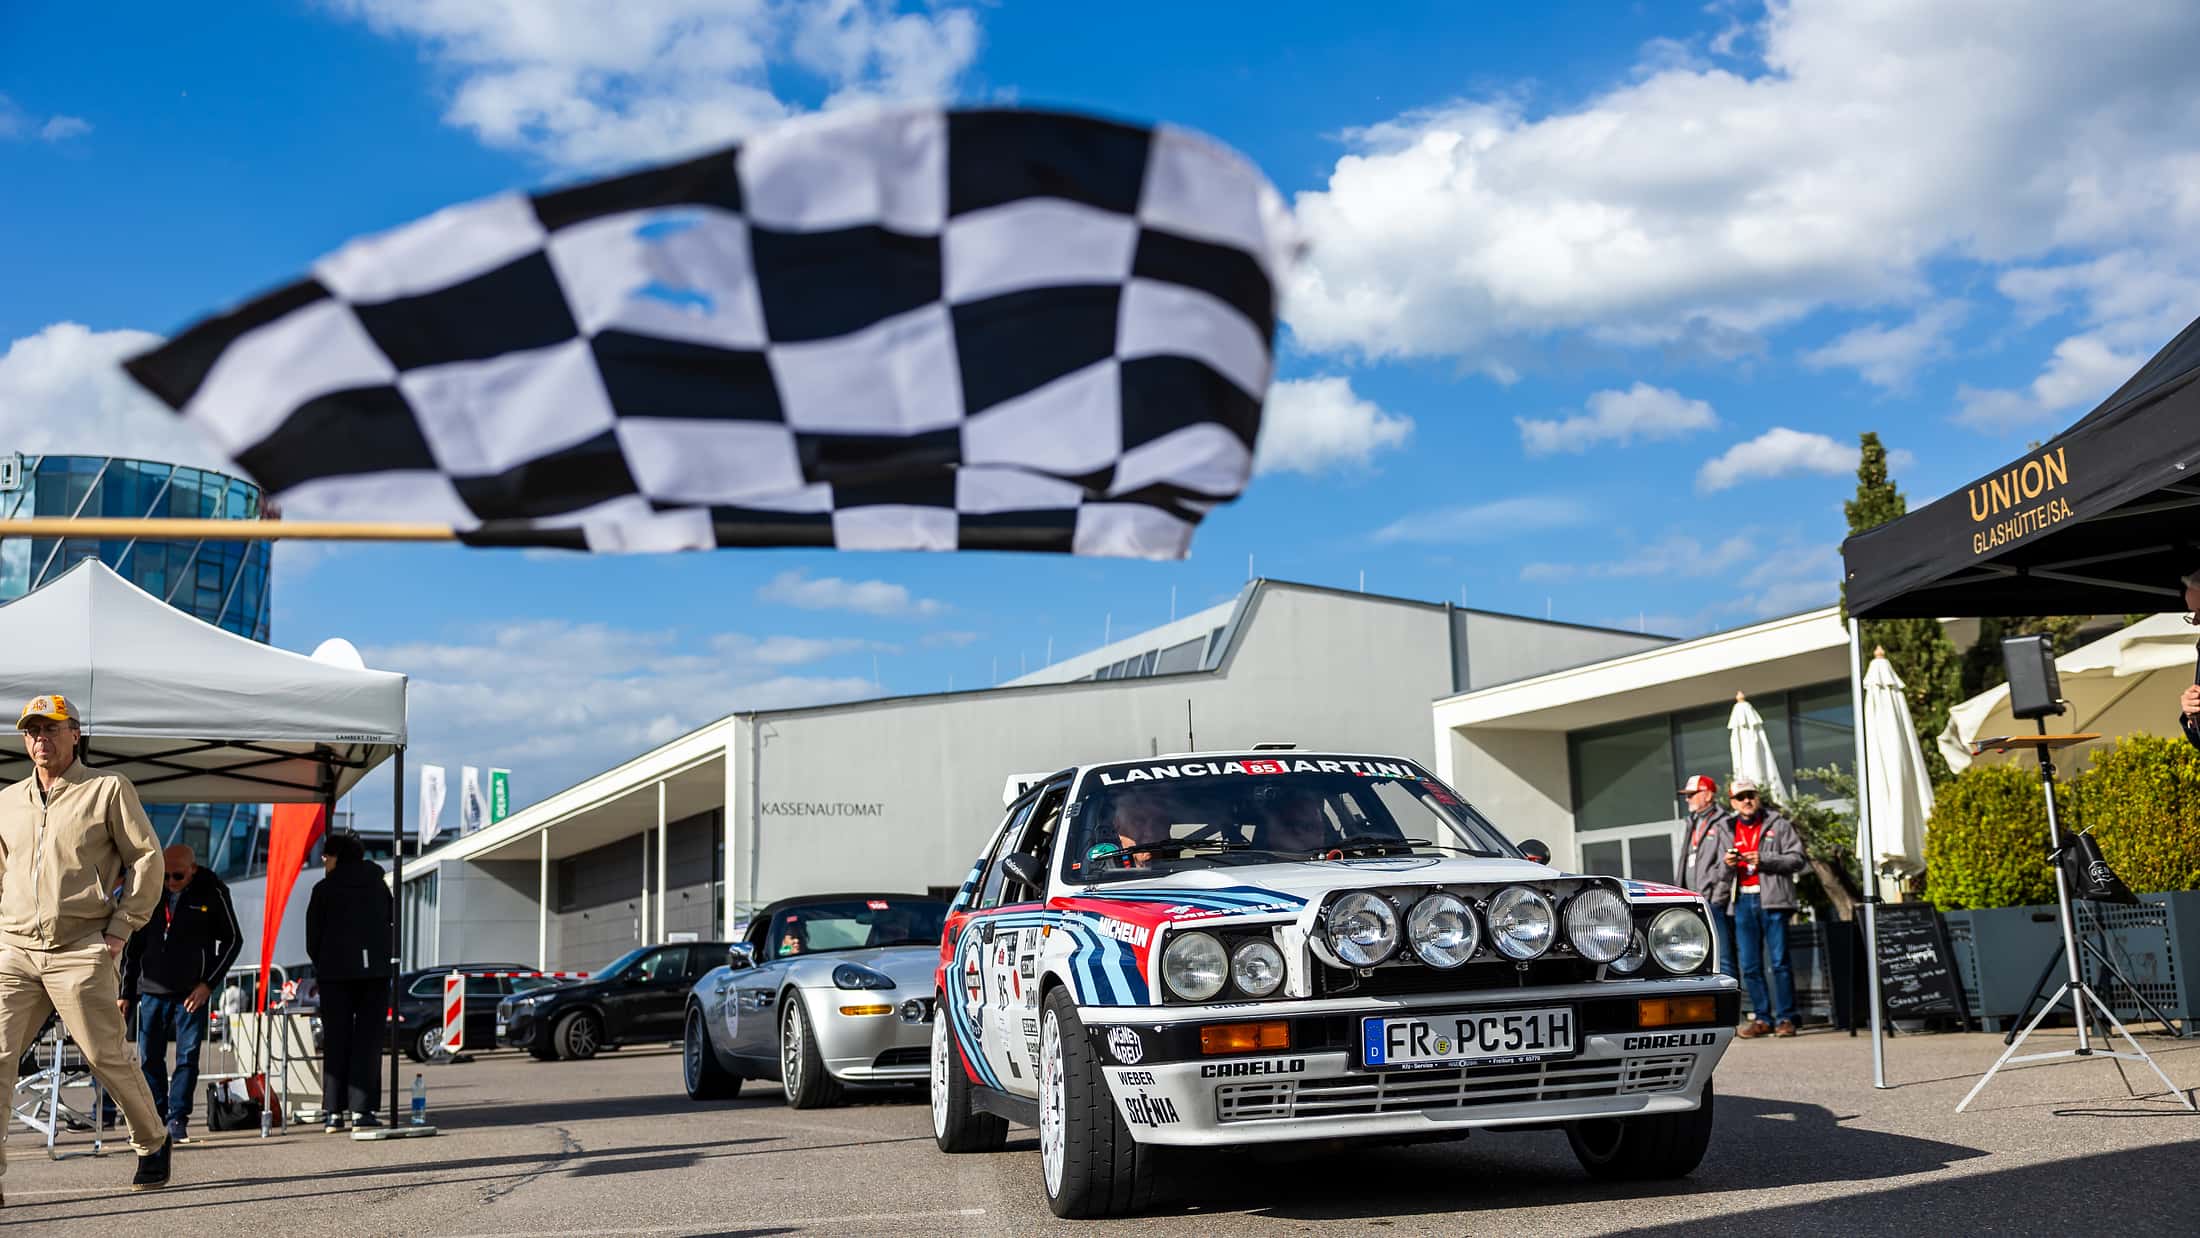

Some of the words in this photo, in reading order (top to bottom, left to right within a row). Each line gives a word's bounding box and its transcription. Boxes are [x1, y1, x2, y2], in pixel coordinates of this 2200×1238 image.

[1968, 447, 2068, 521] UNION
[1100, 761, 1247, 785] LANCIA
[1251, 764, 1275, 774] 85
[761, 802, 884, 816] KASSENAUTOMAT
[1097, 916, 1150, 948] MICHELIN
[1371, 1048, 1379, 1057] D
[1386, 1022, 1431, 1058] FR
[1624, 1032, 1716, 1050] CARELLO
[1201, 1059, 1305, 1078] CARELLO
[1118, 1072, 1155, 1085] WEBER
